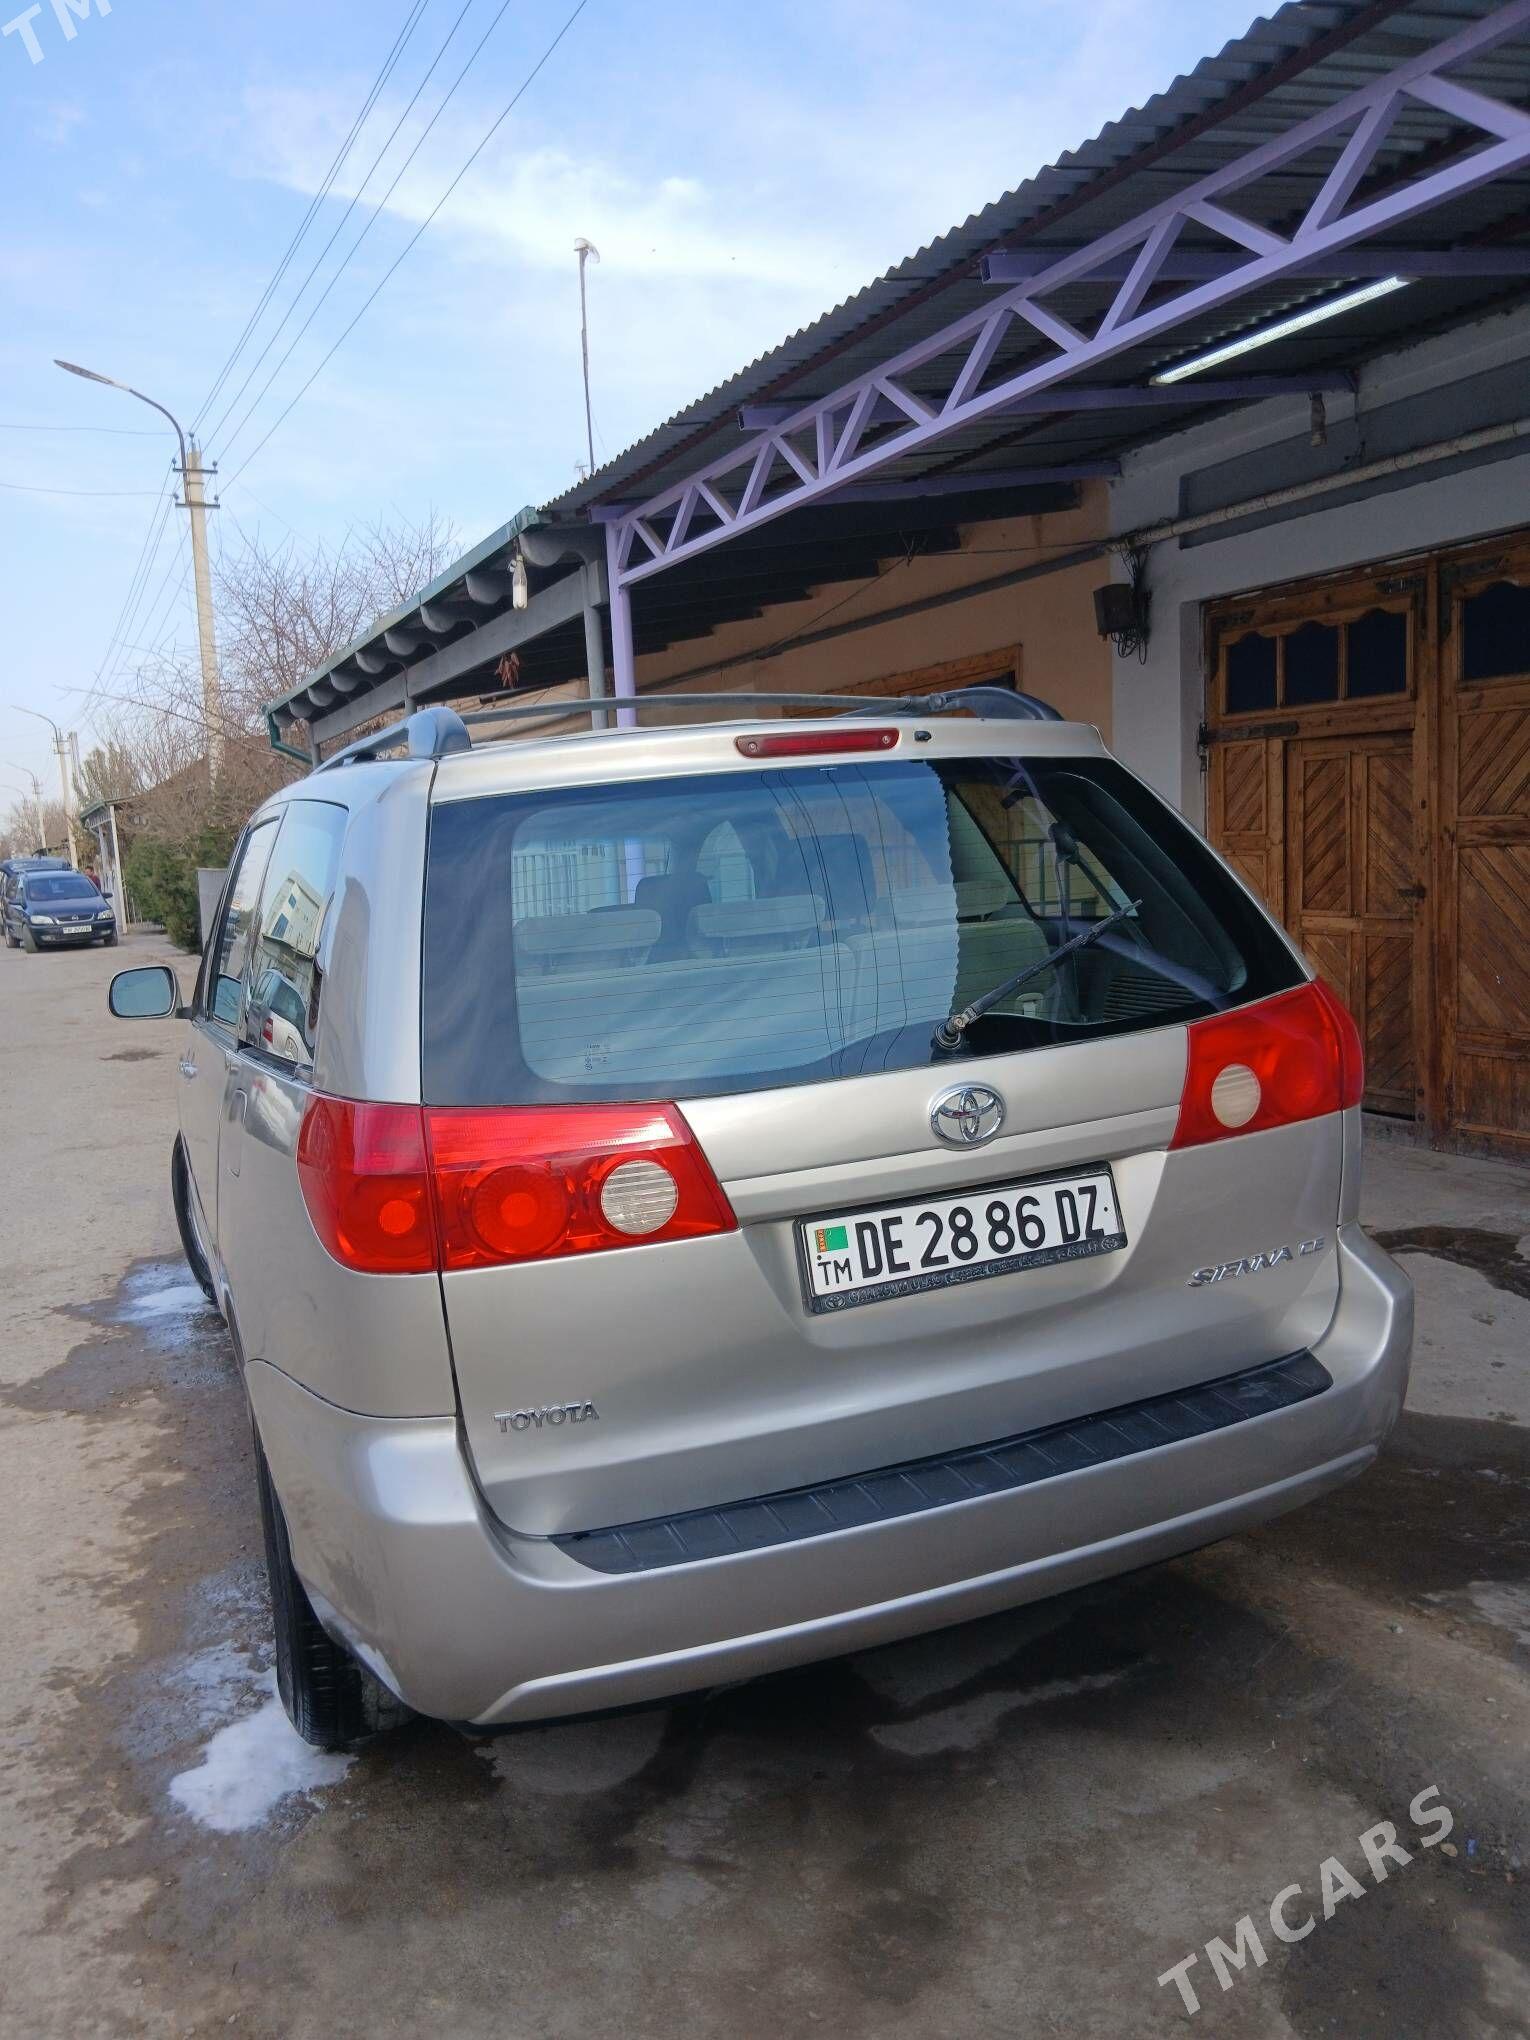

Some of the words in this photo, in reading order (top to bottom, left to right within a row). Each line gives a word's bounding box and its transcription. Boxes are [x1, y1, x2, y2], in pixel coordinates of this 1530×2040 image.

[855, 1216, 910, 1279] DE
[1054, 1185, 1105, 1244] DZ
[817, 1257, 852, 1286] TM
[1185, 1246, 1294, 1287] SIENNA
[493, 1400, 600, 1433] TOYOTA
